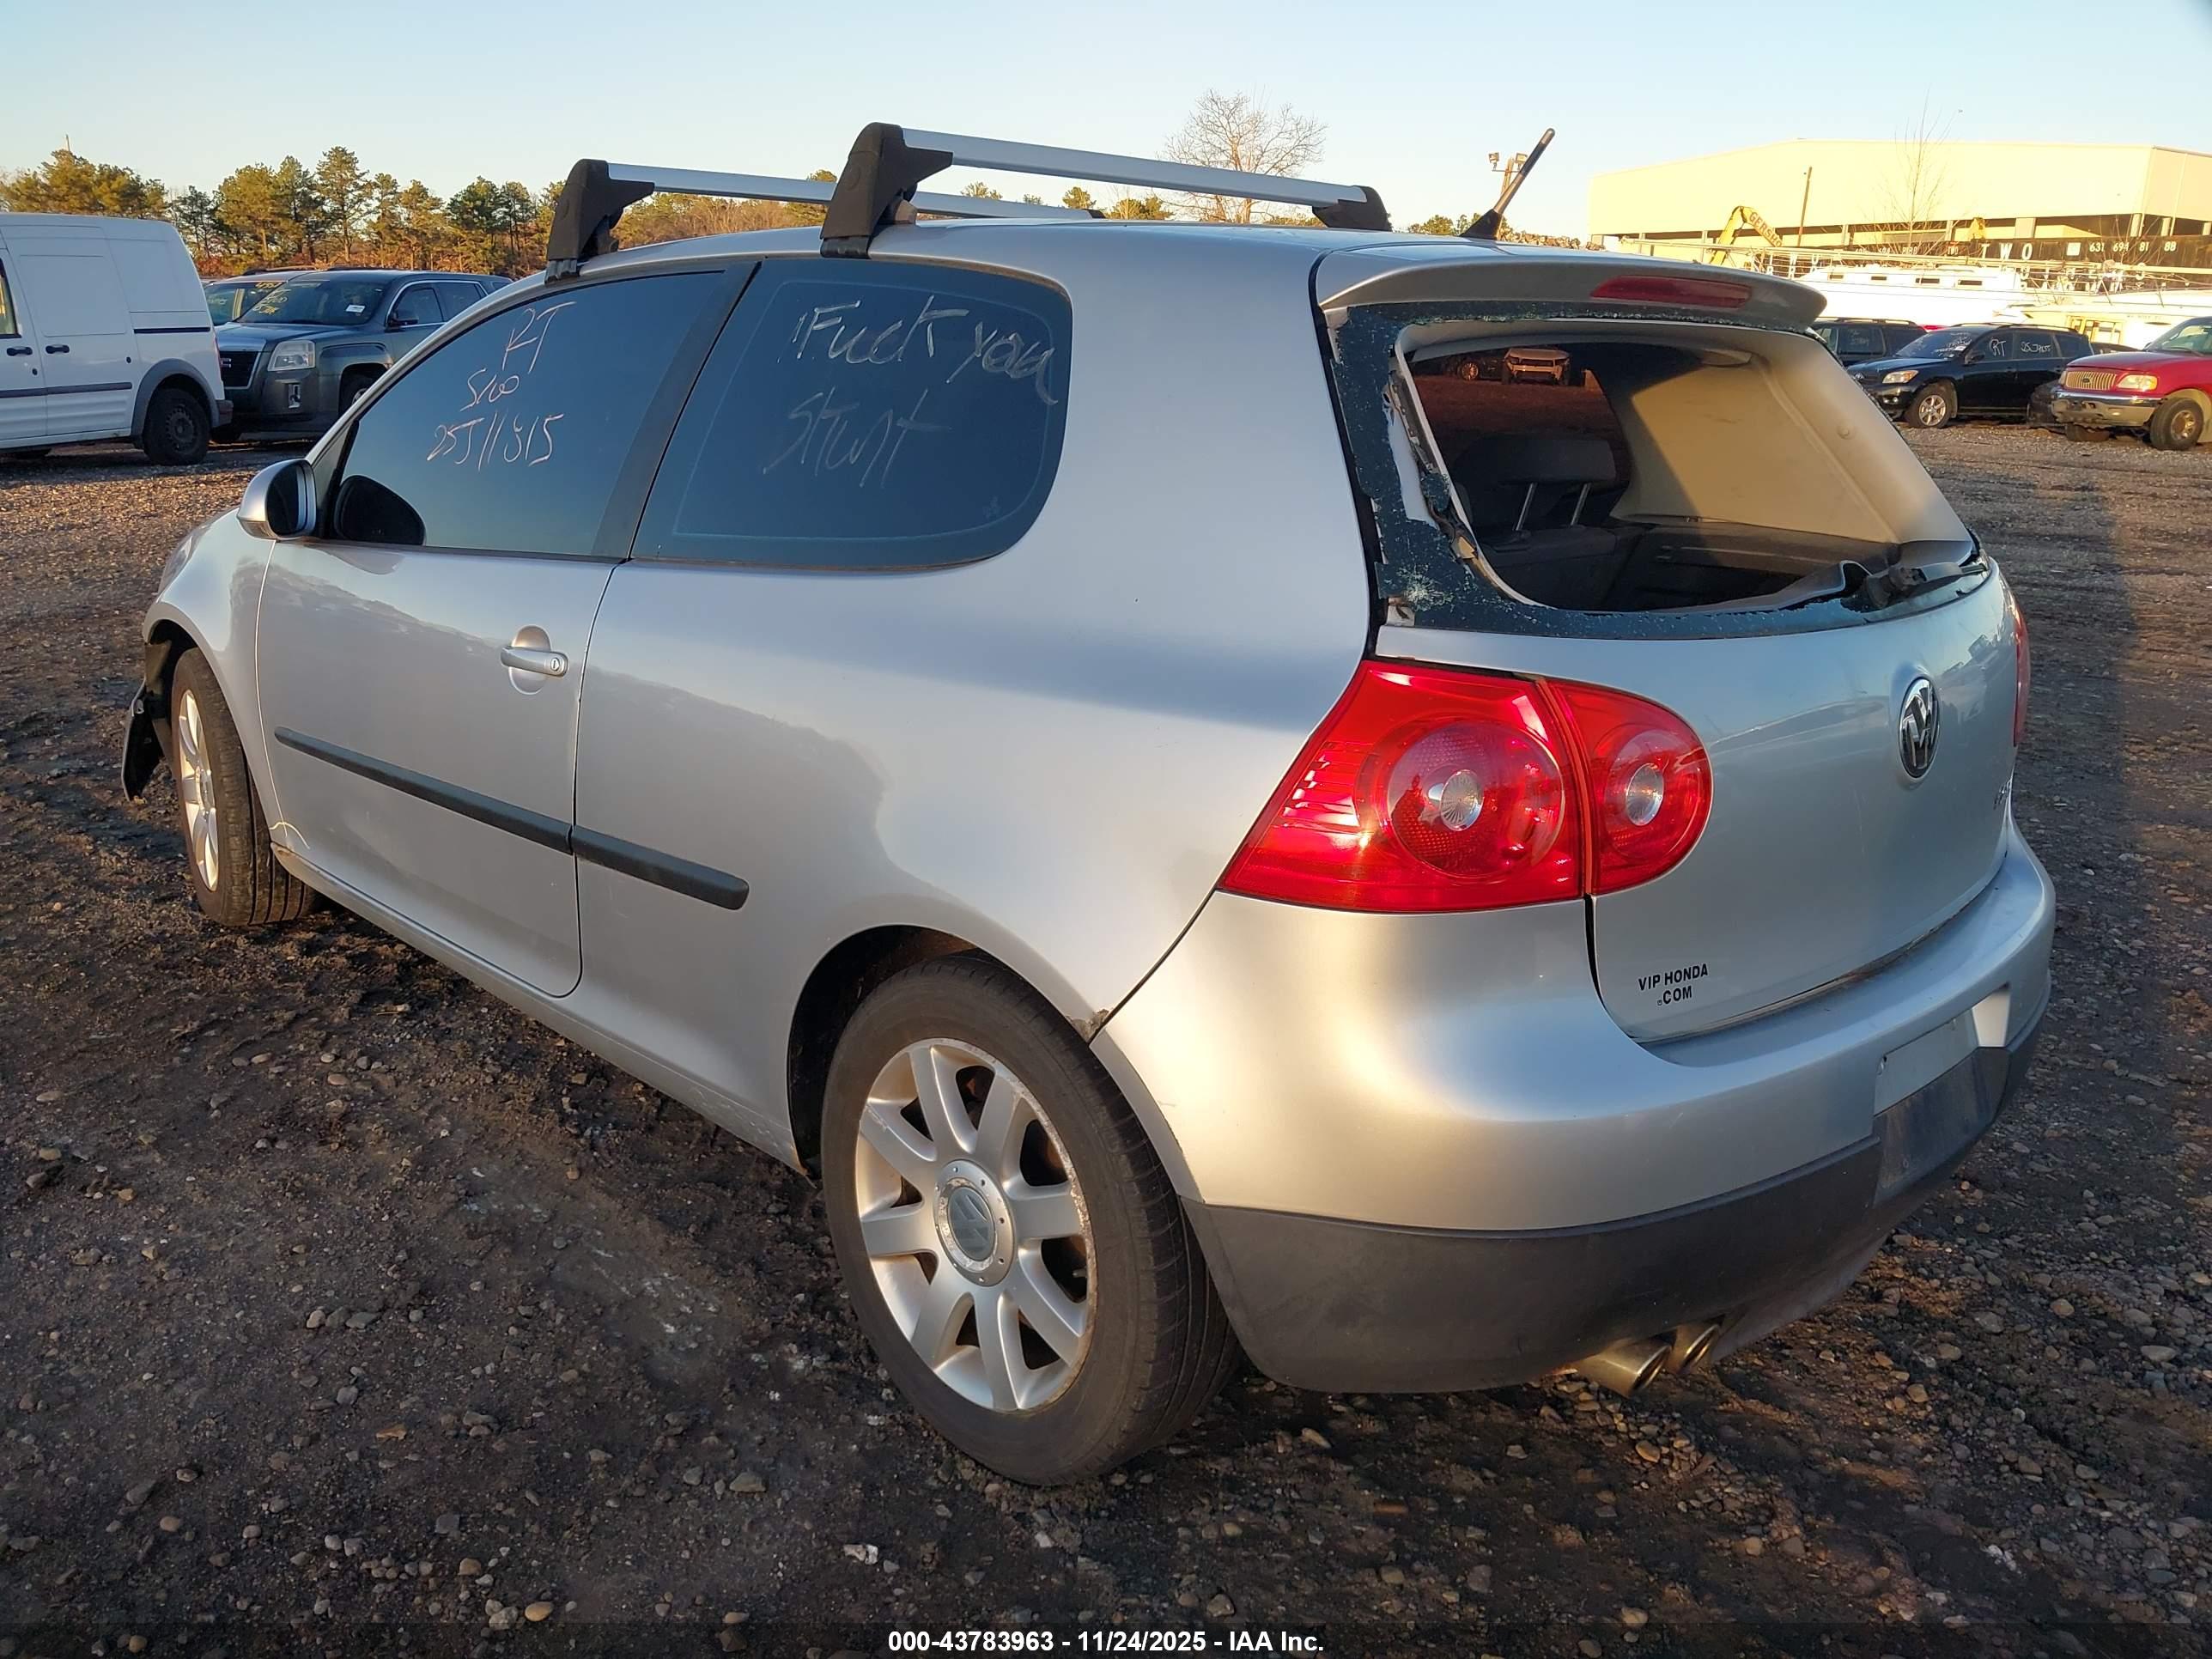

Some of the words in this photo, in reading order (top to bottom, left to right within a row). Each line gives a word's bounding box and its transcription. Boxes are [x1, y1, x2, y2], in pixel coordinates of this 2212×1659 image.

[2089, 241, 2105, 252] 631
[1638, 974, 1661, 991] VIP
[1664, 963, 1708, 986] HONDA
